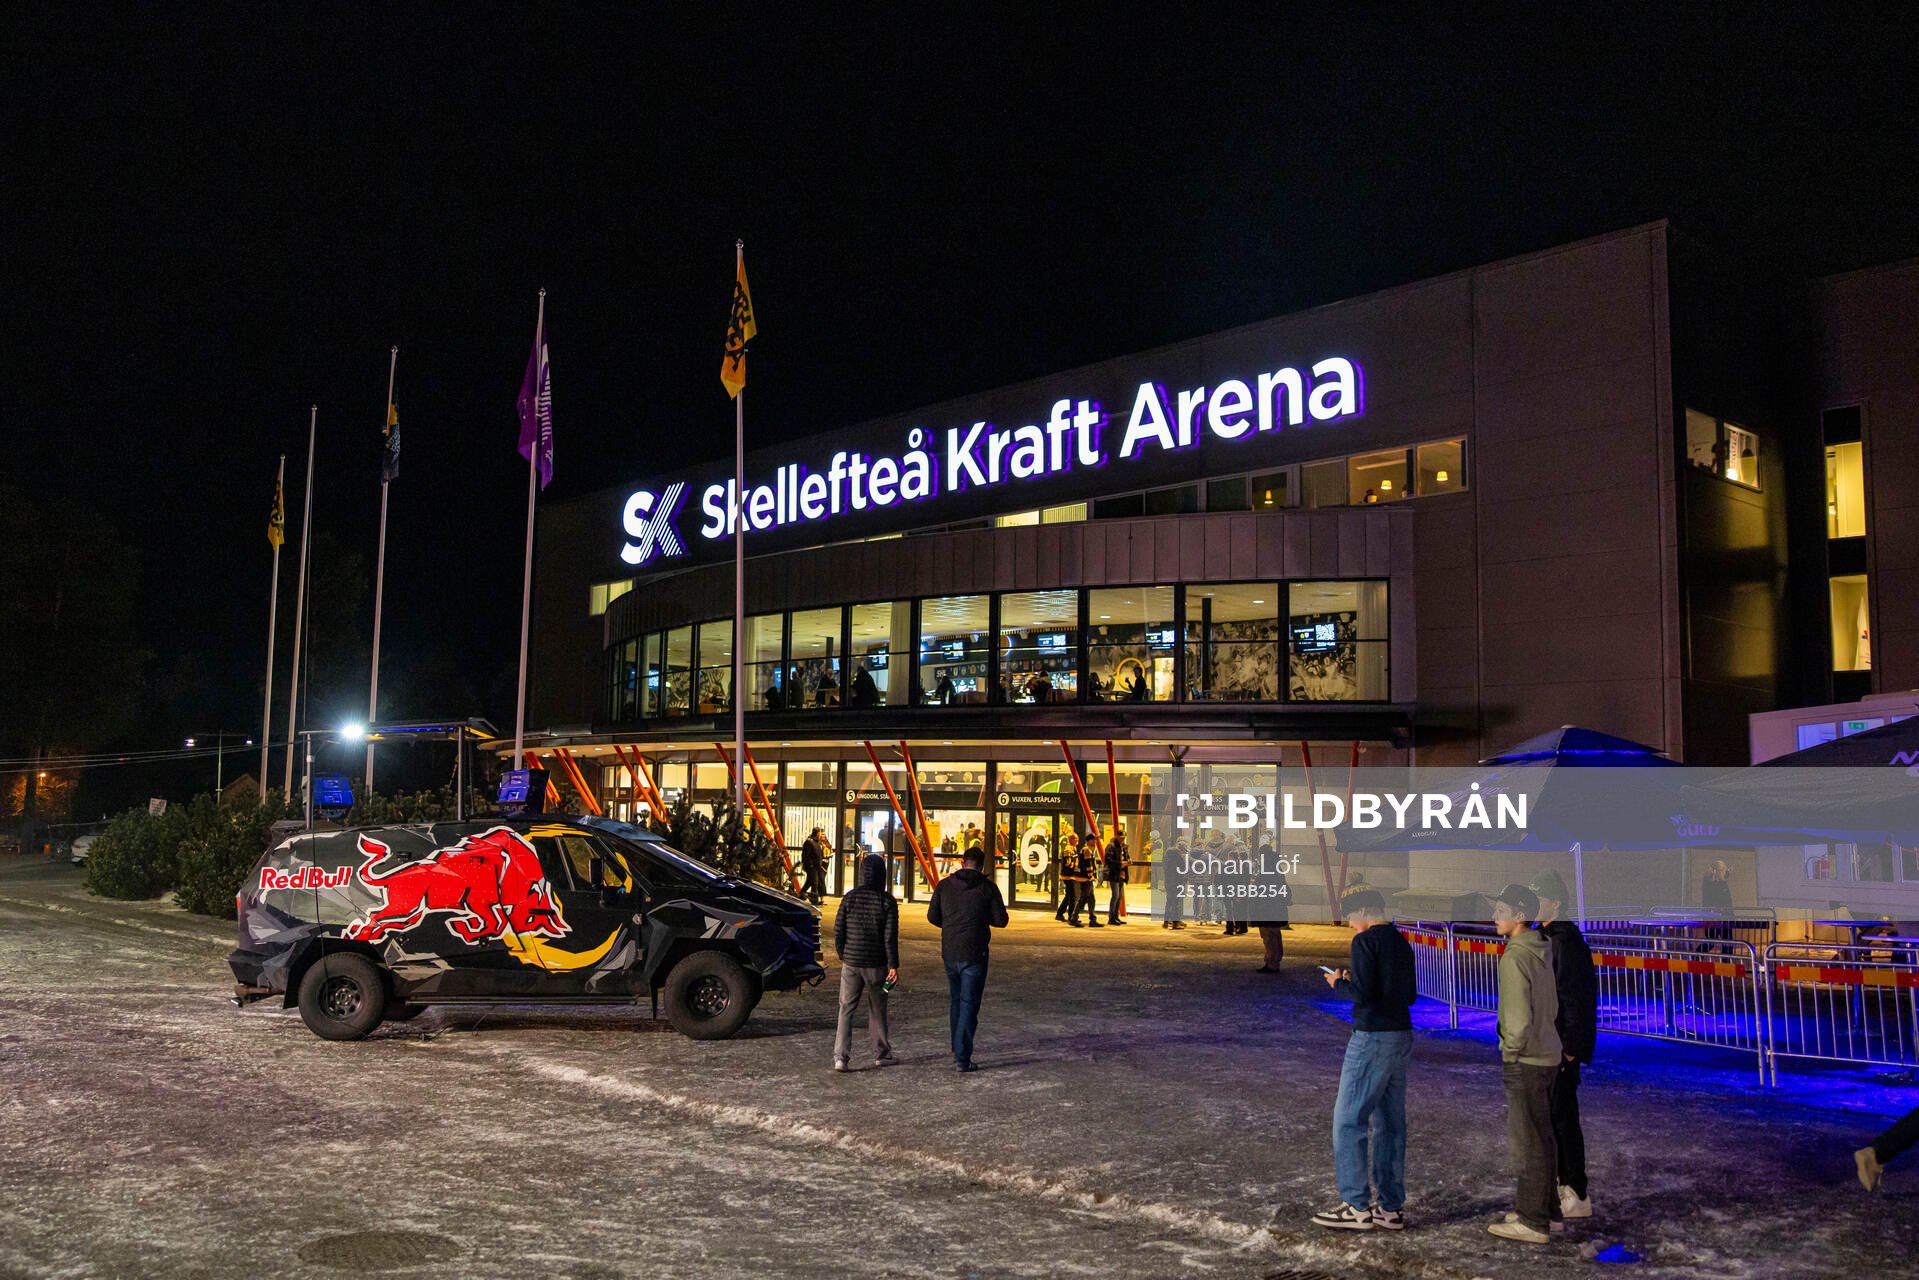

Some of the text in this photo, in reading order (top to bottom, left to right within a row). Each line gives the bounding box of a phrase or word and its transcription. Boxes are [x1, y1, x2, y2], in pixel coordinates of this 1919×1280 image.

[701, 357, 1356, 539] Skellefteå Kraft Arena
[1034, 795, 1061, 803] STÅPLATS
[1020, 827, 1049, 875] 6
[259, 866, 353, 889] Red Bull
